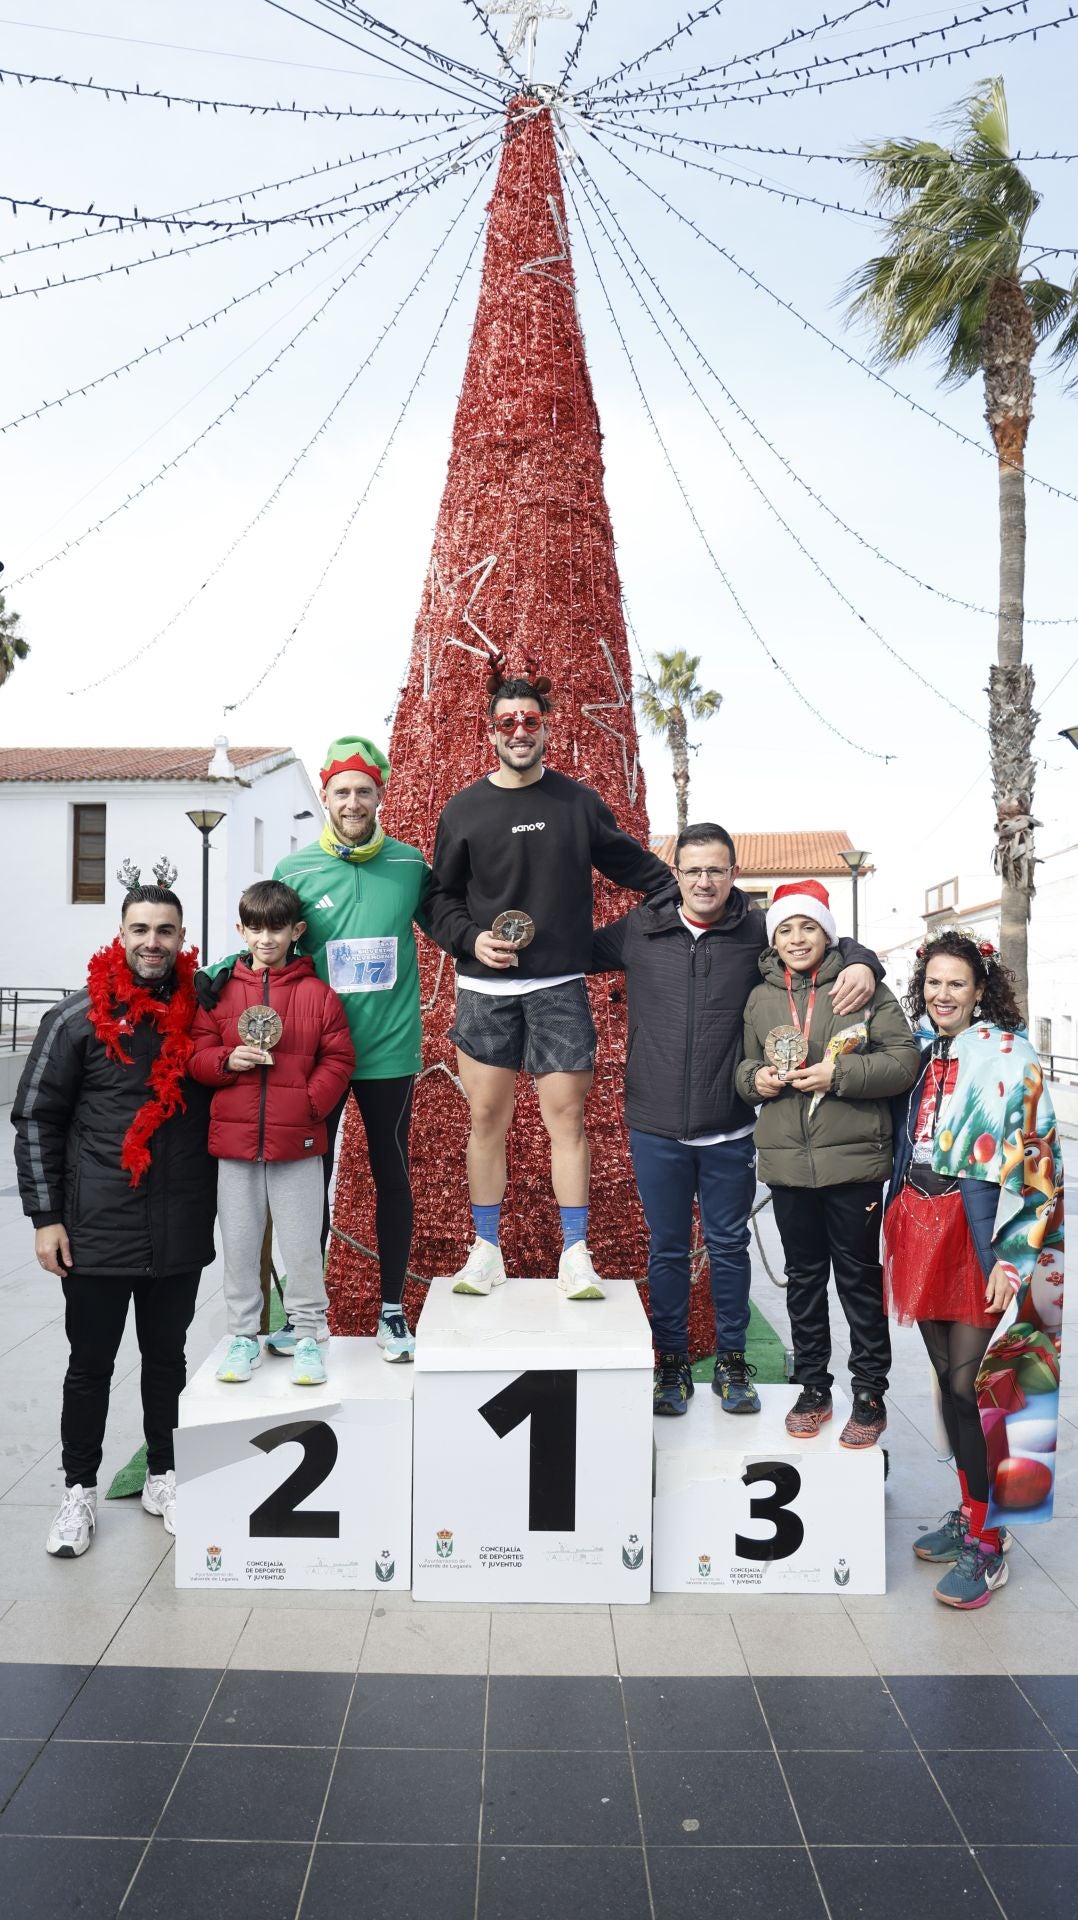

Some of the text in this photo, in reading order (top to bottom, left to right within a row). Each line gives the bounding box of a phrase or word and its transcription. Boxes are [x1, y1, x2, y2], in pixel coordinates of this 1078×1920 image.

[352, 961, 387, 984] 17
[249, 1420, 340, 1538] 2
[477, 1370, 577, 1532] 1
[735, 1461, 805, 1561] 3
